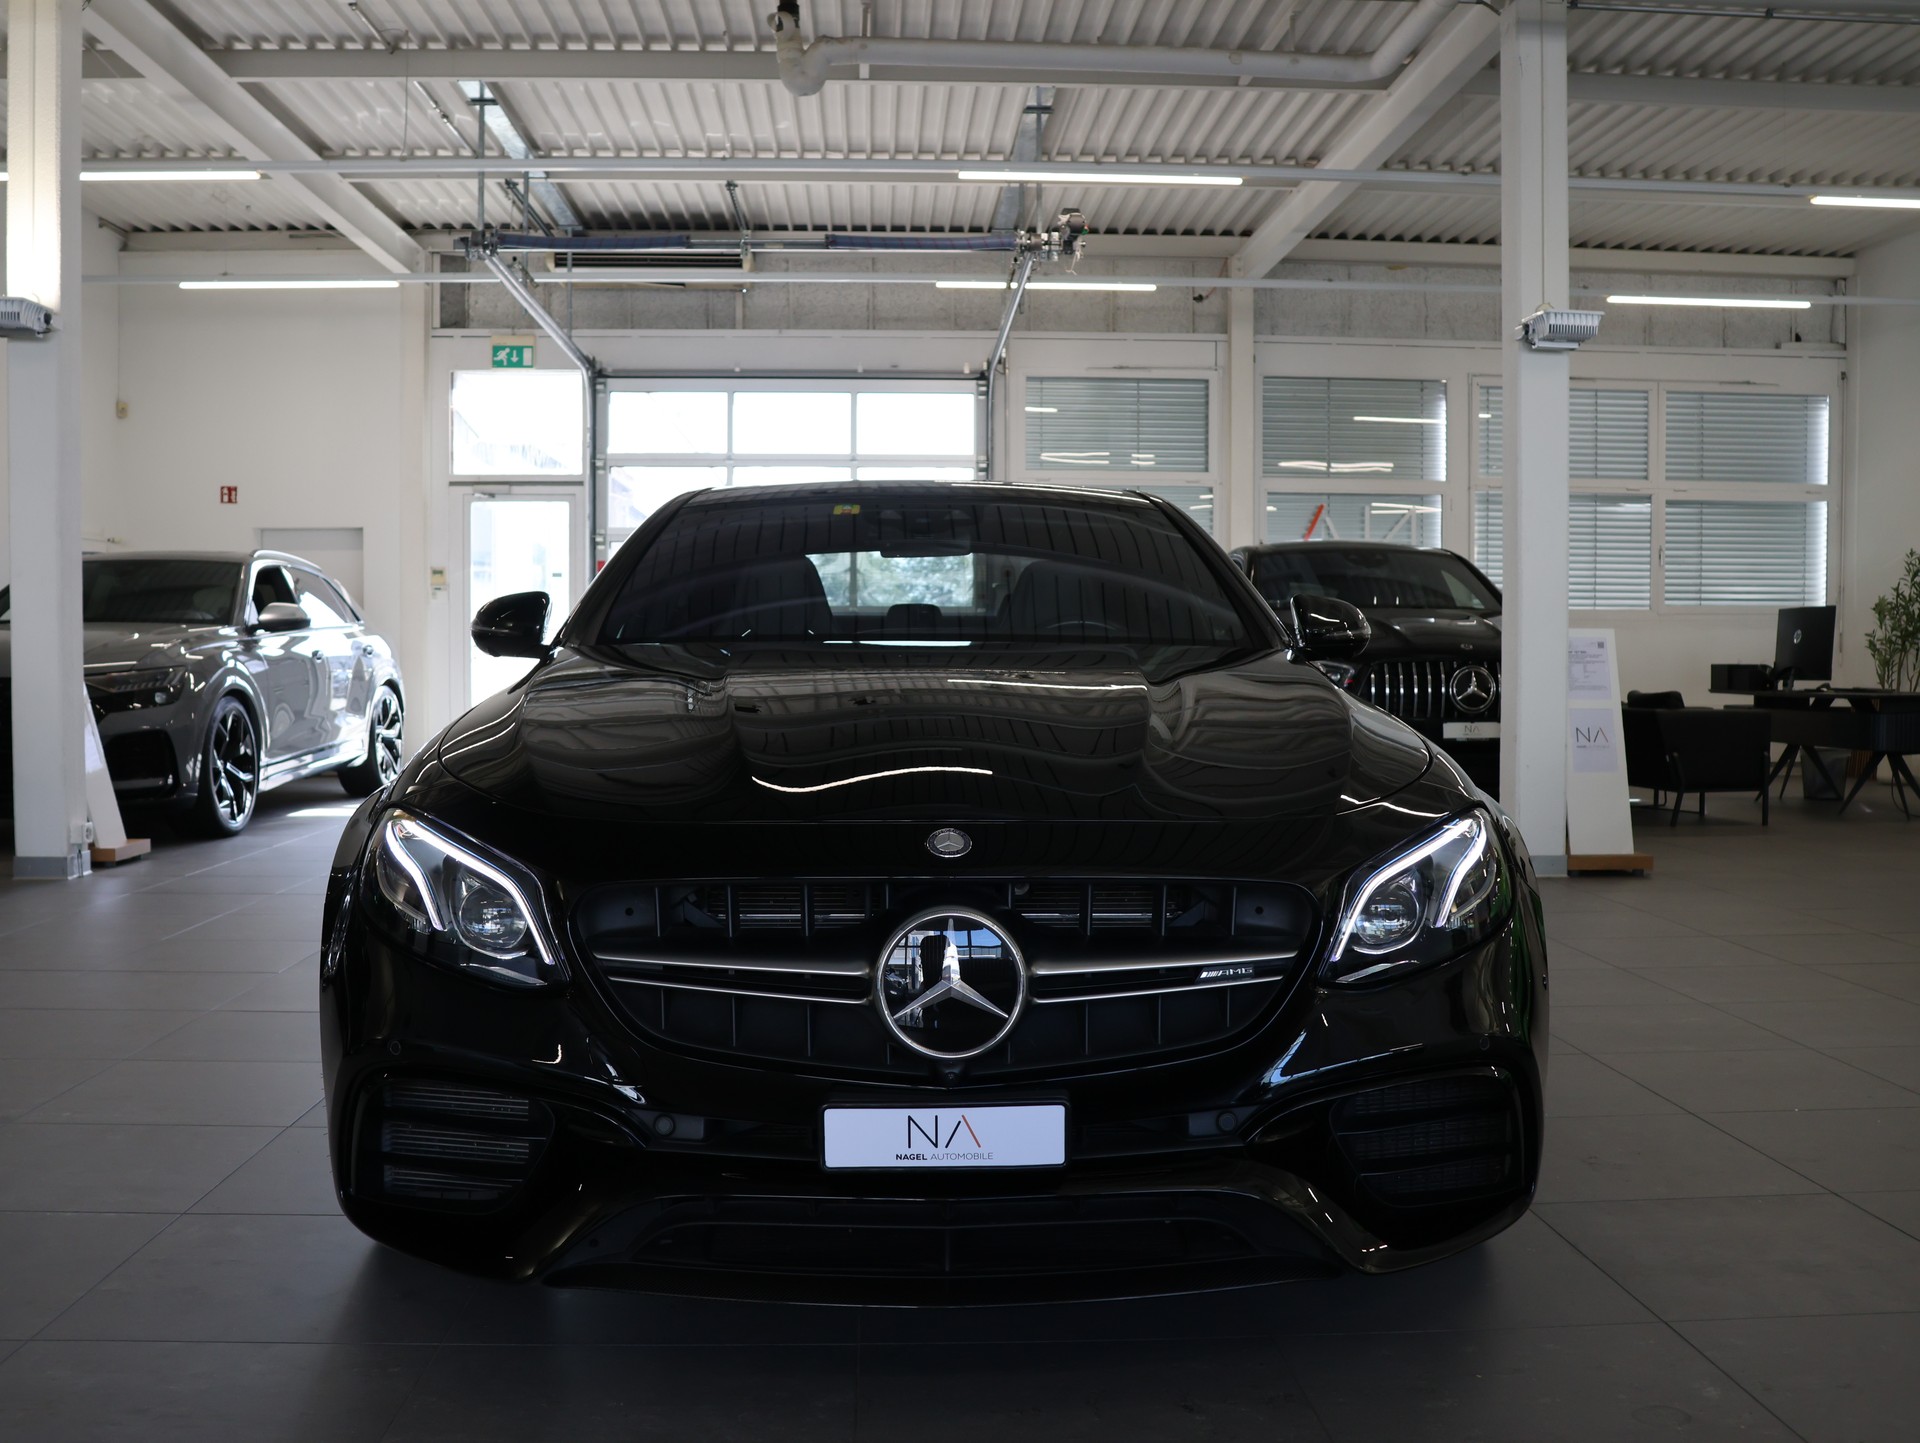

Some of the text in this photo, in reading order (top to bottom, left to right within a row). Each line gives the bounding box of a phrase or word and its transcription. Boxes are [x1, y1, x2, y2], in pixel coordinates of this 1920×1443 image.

[1576, 727, 1609, 743] NA
[1218, 967, 1253, 976] AMG
[907, 1115, 981, 1149] NA
[895, 1152, 994, 1161] NAGEL AUTOMOBILE
